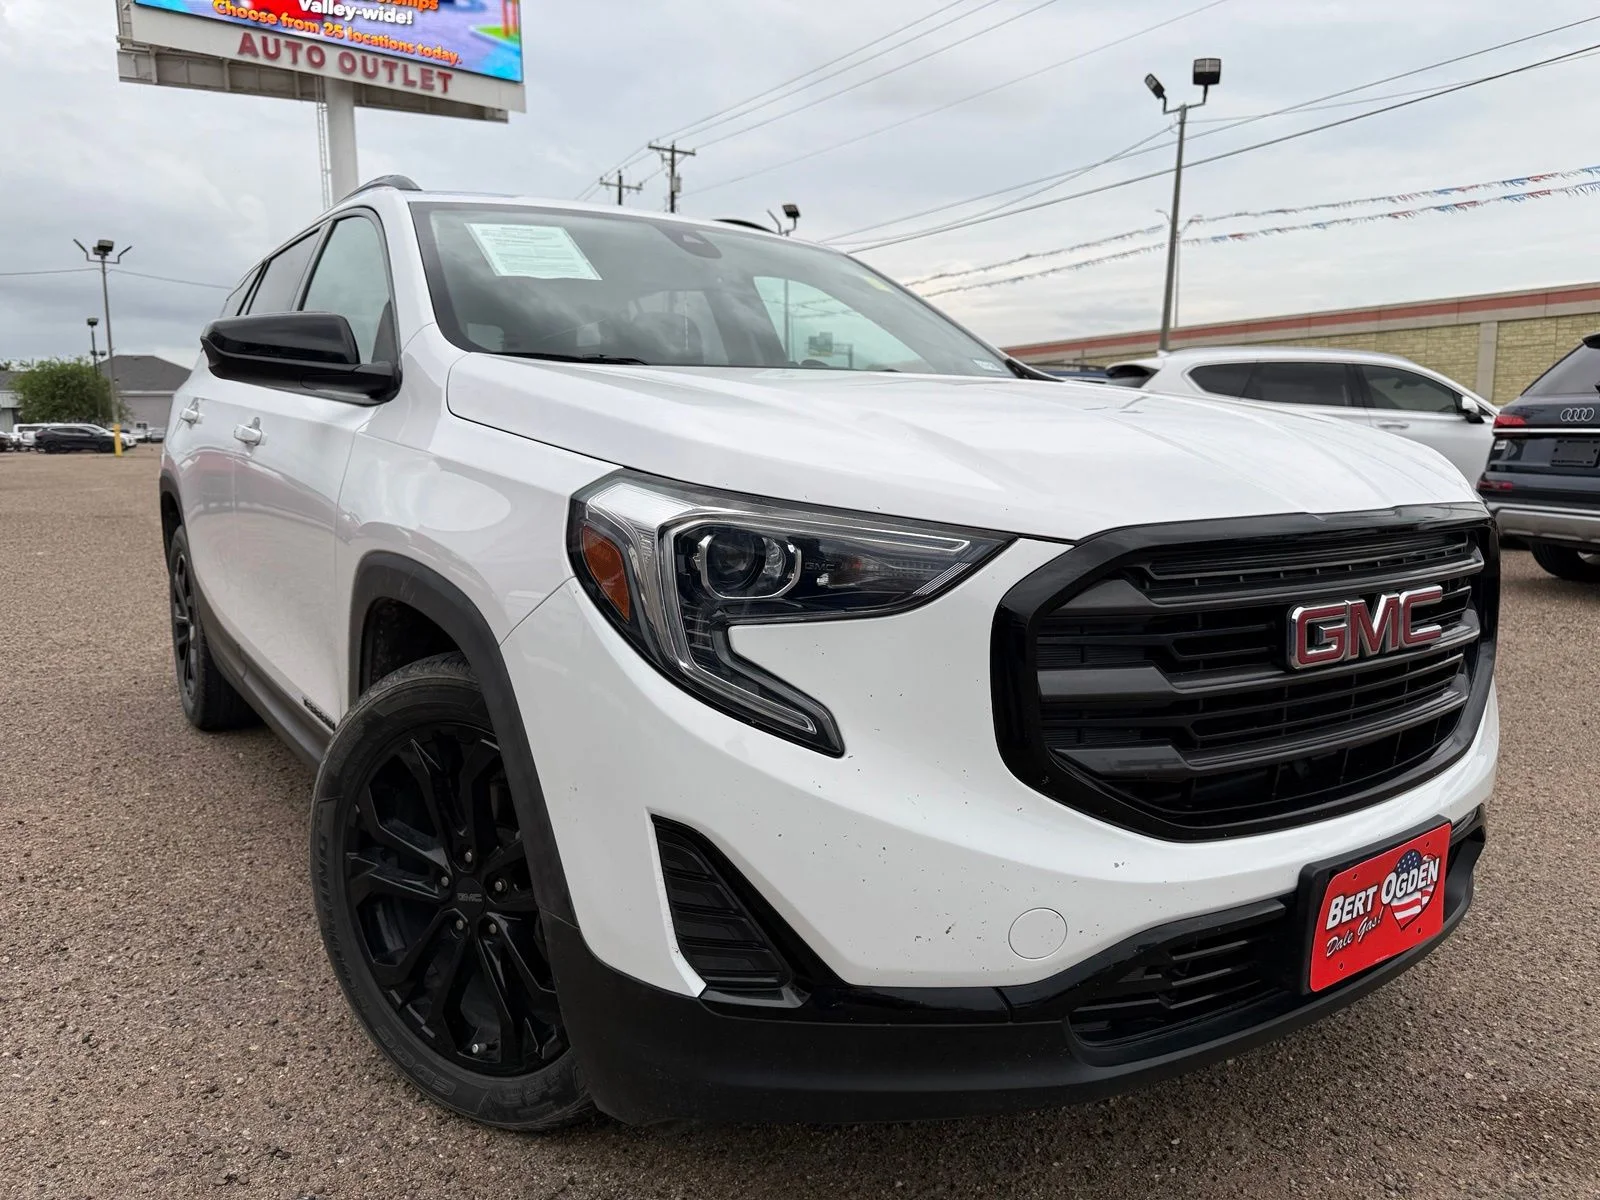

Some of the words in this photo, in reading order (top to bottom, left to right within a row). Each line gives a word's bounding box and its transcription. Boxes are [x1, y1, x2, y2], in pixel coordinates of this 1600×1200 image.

[212, 0, 278, 25] Choose
[280, 12, 320, 34] from
[323, 22, 345, 39] 25
[347, 26, 416, 55] locations
[417, 43, 463, 66] today.
[299, 0, 413, 25] Valley-wide!
[237, 32, 326, 69] AUTO
[338, 51, 453, 94] OUTLET
[1288, 586, 1443, 670] GMC
[1325, 884, 1379, 931] BERT
[1380, 857, 1440, 905] OGDEN
[1326, 931, 1354, 958] Dale
[1357, 905, 1384, 943] Gas!
